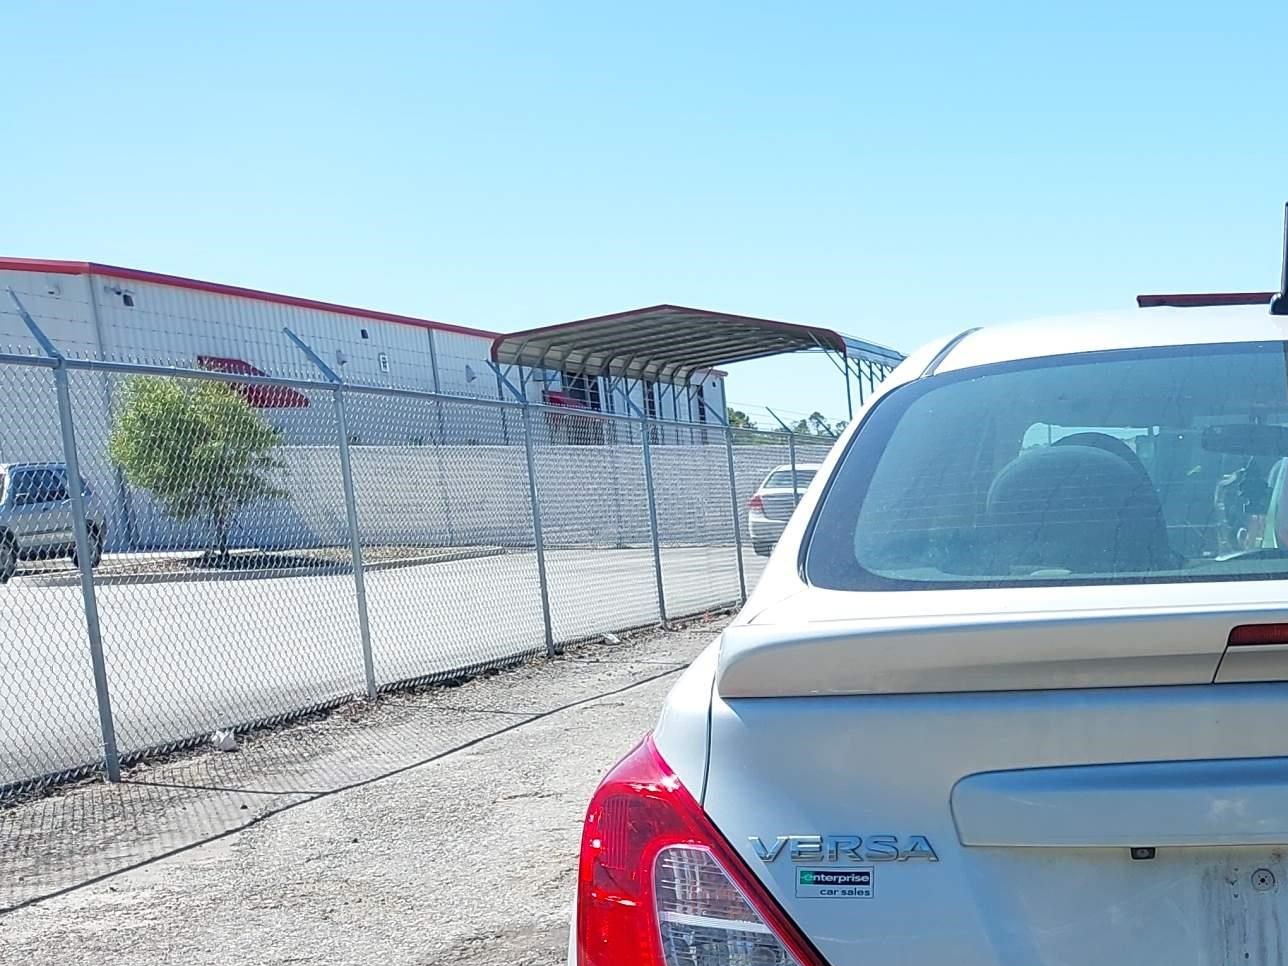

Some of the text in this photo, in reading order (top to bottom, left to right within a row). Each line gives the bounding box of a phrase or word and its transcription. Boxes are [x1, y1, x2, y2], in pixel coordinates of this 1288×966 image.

[748, 835, 939, 862] VERSA
[801, 873, 870, 884] enterprise
[840, 887, 871, 896] sales
